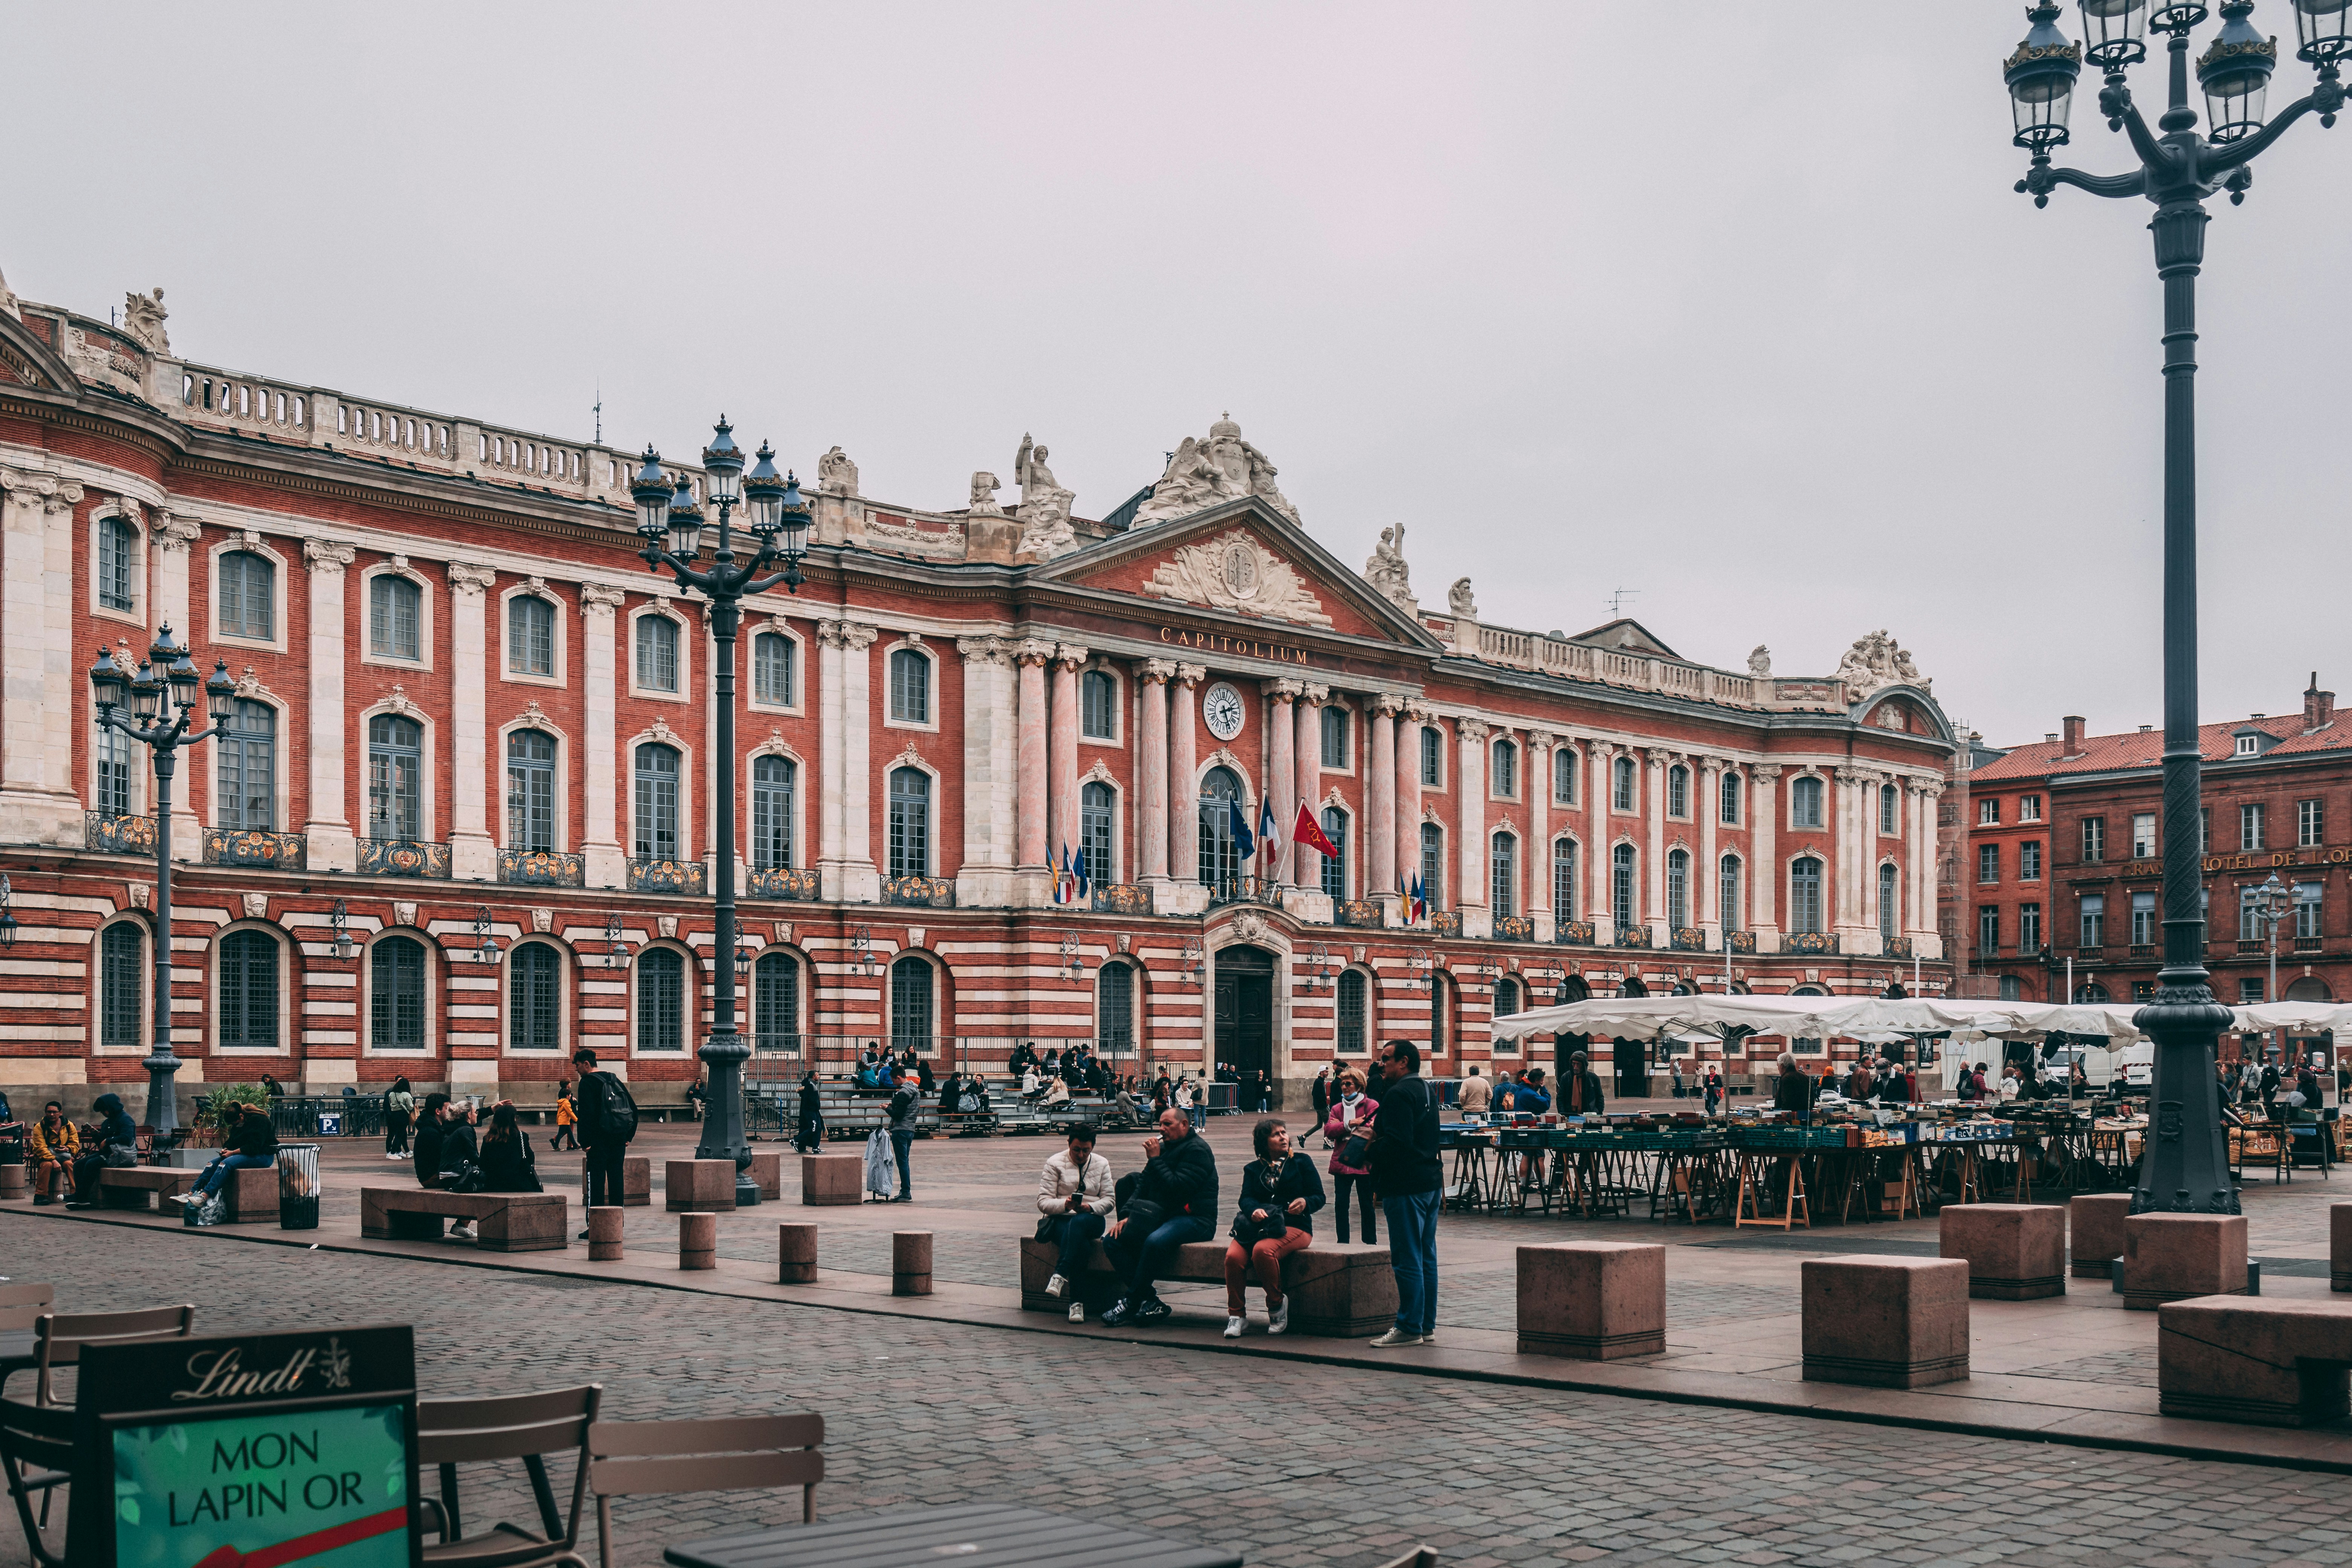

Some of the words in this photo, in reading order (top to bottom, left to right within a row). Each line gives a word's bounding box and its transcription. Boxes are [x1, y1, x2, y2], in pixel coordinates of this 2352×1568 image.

[1161, 627, 1307, 664] CAPITOLIUM
[2123, 862, 2164, 875] GRAN
[2271, 853, 2295, 867] DE
[323, 1119, 332, 1130] P
[170, 1347, 317, 1401] Lindt
[212, 1430, 318, 1474] MON
[169, 1479, 287, 1527] LAPIN
[303, 1472, 364, 1510] OR
